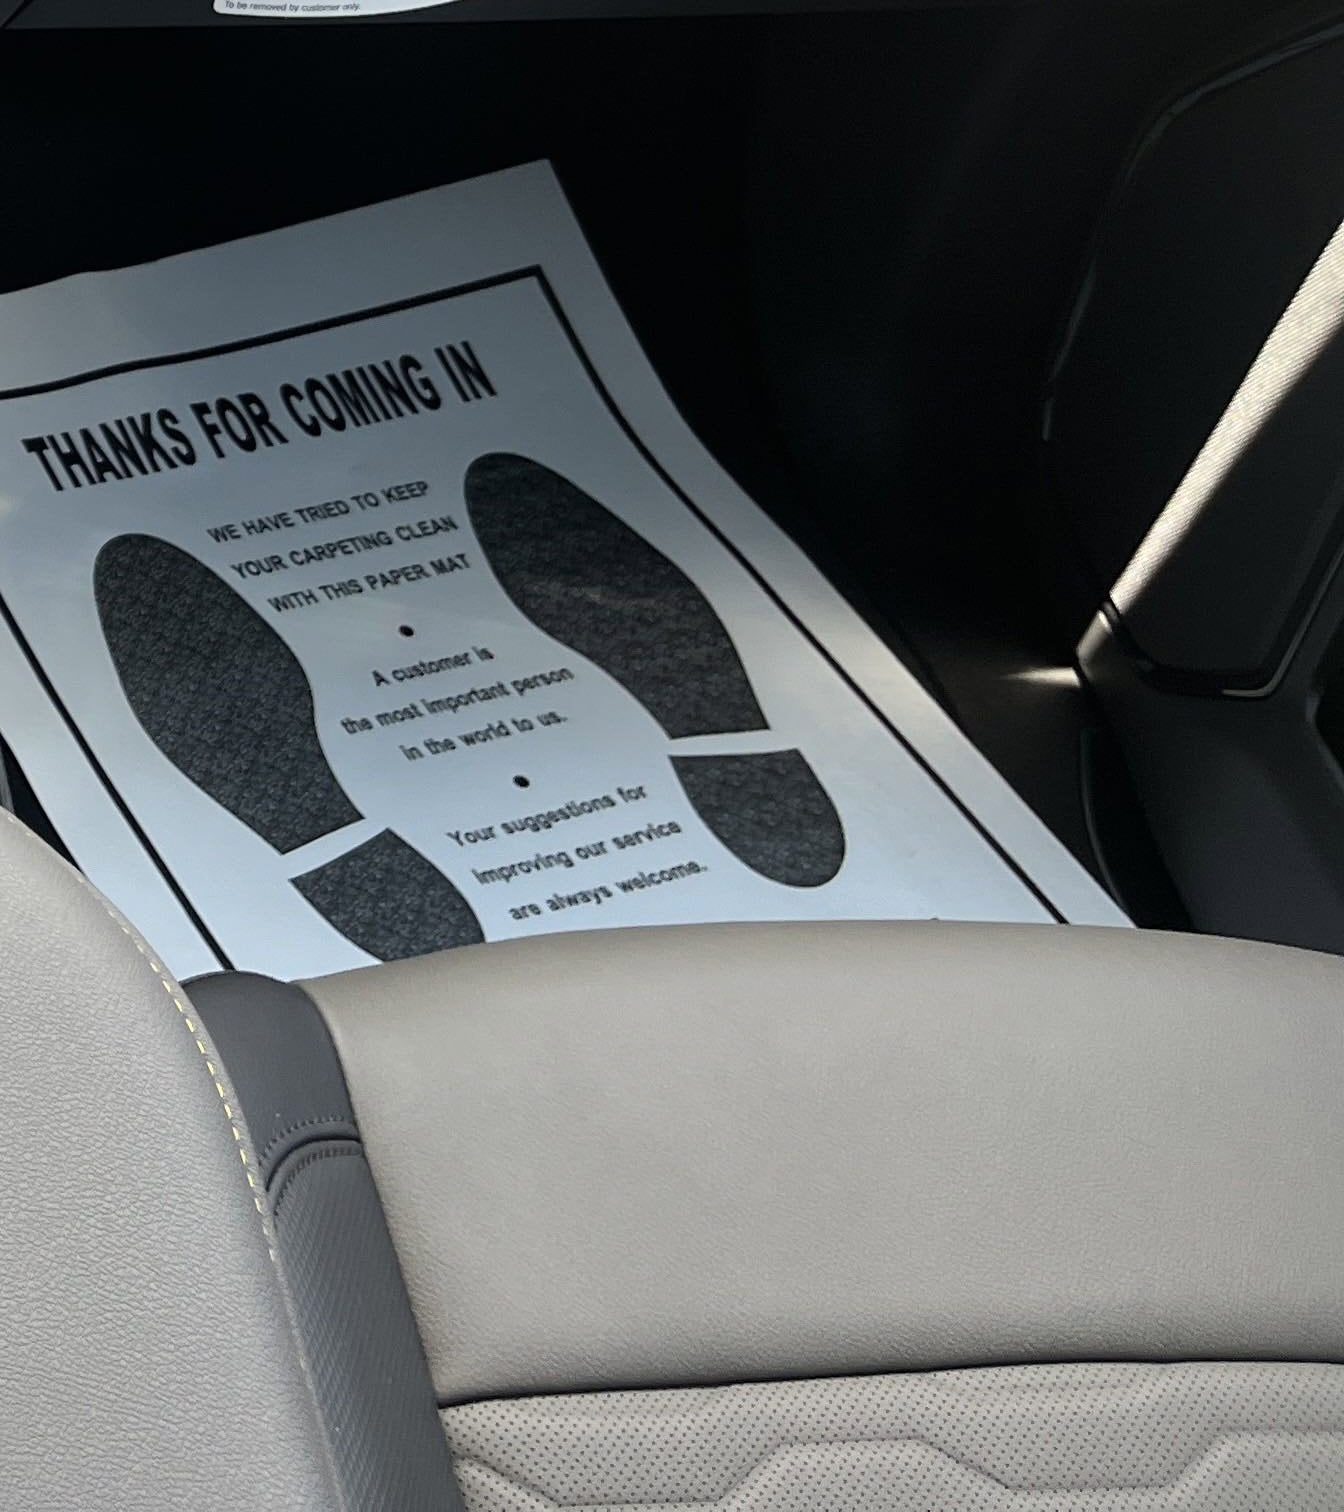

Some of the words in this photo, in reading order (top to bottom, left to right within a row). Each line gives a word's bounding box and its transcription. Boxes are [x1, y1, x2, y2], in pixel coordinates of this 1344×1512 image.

[21, 408, 197, 491] THANKS
[189, 392, 290, 447] FOR
[279, 354, 442, 438] COMING
[433, 340, 498, 403] IN
[206, 524, 242, 544] WE
[242, 511, 296, 537] HAVE
[294, 499, 351, 525] TRIED
[350, 491, 381, 511] TO
[381, 480, 430, 504] KEEP
[230, 554, 288, 580] YOUR
[288, 530, 394, 567] CARPETING
[394, 515, 460, 542] CLEAN
[267, 589, 319, 613] WITH
[318, 578, 364, 602] THIS
[364, 563, 432, 591] PAPER
[429, 553, 472, 576] MAT
[372, 669, 391, 687] A
[391, 651, 474, 683] customer
[471, 645, 496, 662] is
[340, 716, 374, 736] the
[374, 702, 425, 728] most
[419, 680, 511, 714] important
[510, 666, 576, 697] person
[398, 744, 426, 762] in
[423, 737, 458, 756] the
[456, 719, 512, 747] world
[509, 716, 535, 733] to
[536, 710, 569, 728] us.
[446, 824, 497, 847] Your
[500, 793, 617, 835] suggestions
[615, 784, 648, 804] for
[471, 849, 575, 885] improving
[574, 840, 609, 861] our
[611, 820, 683, 851] service
[508, 901, 542, 921] are
[545, 883, 614, 912] always
[614, 858, 709, 894] welcome.
